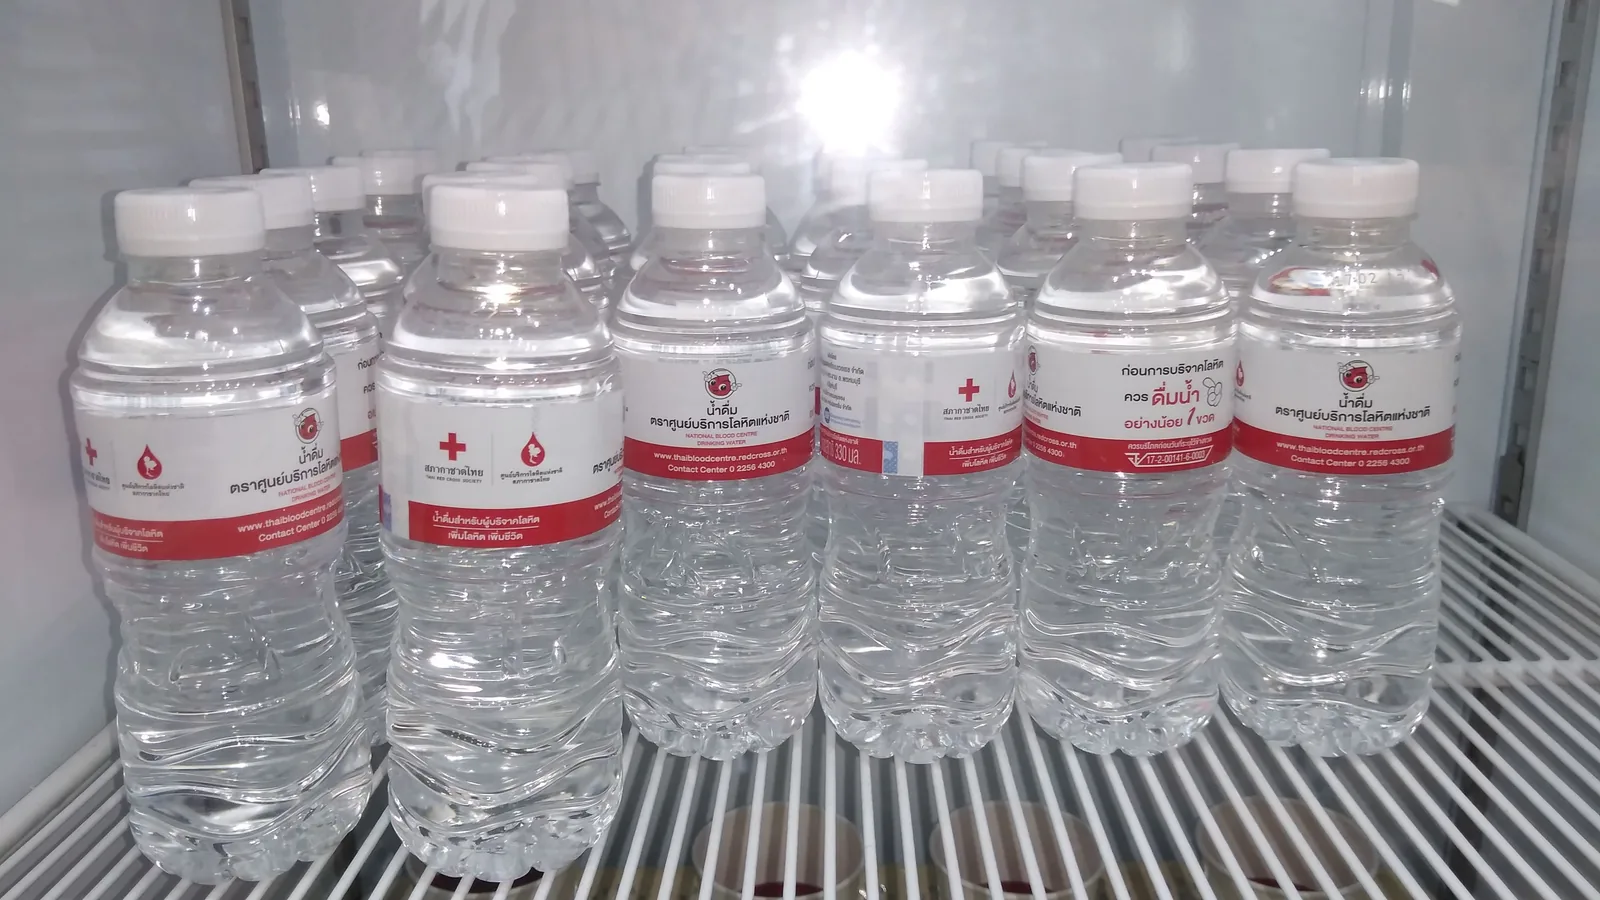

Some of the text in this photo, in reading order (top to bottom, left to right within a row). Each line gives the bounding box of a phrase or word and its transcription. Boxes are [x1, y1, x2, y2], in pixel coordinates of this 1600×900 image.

[1121, 358, 1224, 377] ก่อนการบริจาคโลหิต
[1124, 379, 1200, 406] ควร ดื่มน้ำ
[1338, 392, 1373, 408] น้ำดื่ม
[706, 400, 738, 415] น้ำดื่ม
[943, 404, 990, 415] สภากาชาดไทย
[1275, 405, 1431, 424] ตราศูนย์บริการโลหิตแห่งชาติ
[650, 410, 790, 432] ตราศูนย์บริการโลหิตแห่งชาติ
[1124, 407, 1215, 429] อย่างน้อย 1 ขวด
[736, 431, 758, 439] CENTRE
[726, 439, 747, 447] WATER
[1276, 440, 1425, 457] www.thaibloodcentre.redcross.or.th
[298, 443, 324, 465] น้ำดื่ม
[653, 448, 788, 463] www.thaibloodcentre.redcross.or.th
[834, 442, 847, 462] 330
[1046, 447, 1063, 458] 4300
[1146, 451, 1206, 464] 17-2-00141-6-0003
[667, 464, 699, 474] Contact
[700, 466, 728, 474] Center
[736, 464, 757, 473] 2256
[757, 461, 776, 471] 4300
[1290, 454, 1410, 467] Contact Center 0 2256 4300
[424, 463, 484, 477] สภากาชาดไทย
[432, 510, 541, 529] น้ำดื่มสำหรับผู้บริจาคโลหิต
[258, 527, 295, 543] Contact
[295, 518, 321, 535] Center
[321, 515, 326, 525] 0
[448, 528, 524, 542] เพิ่มโลหิต เพิ่มชีวิต
